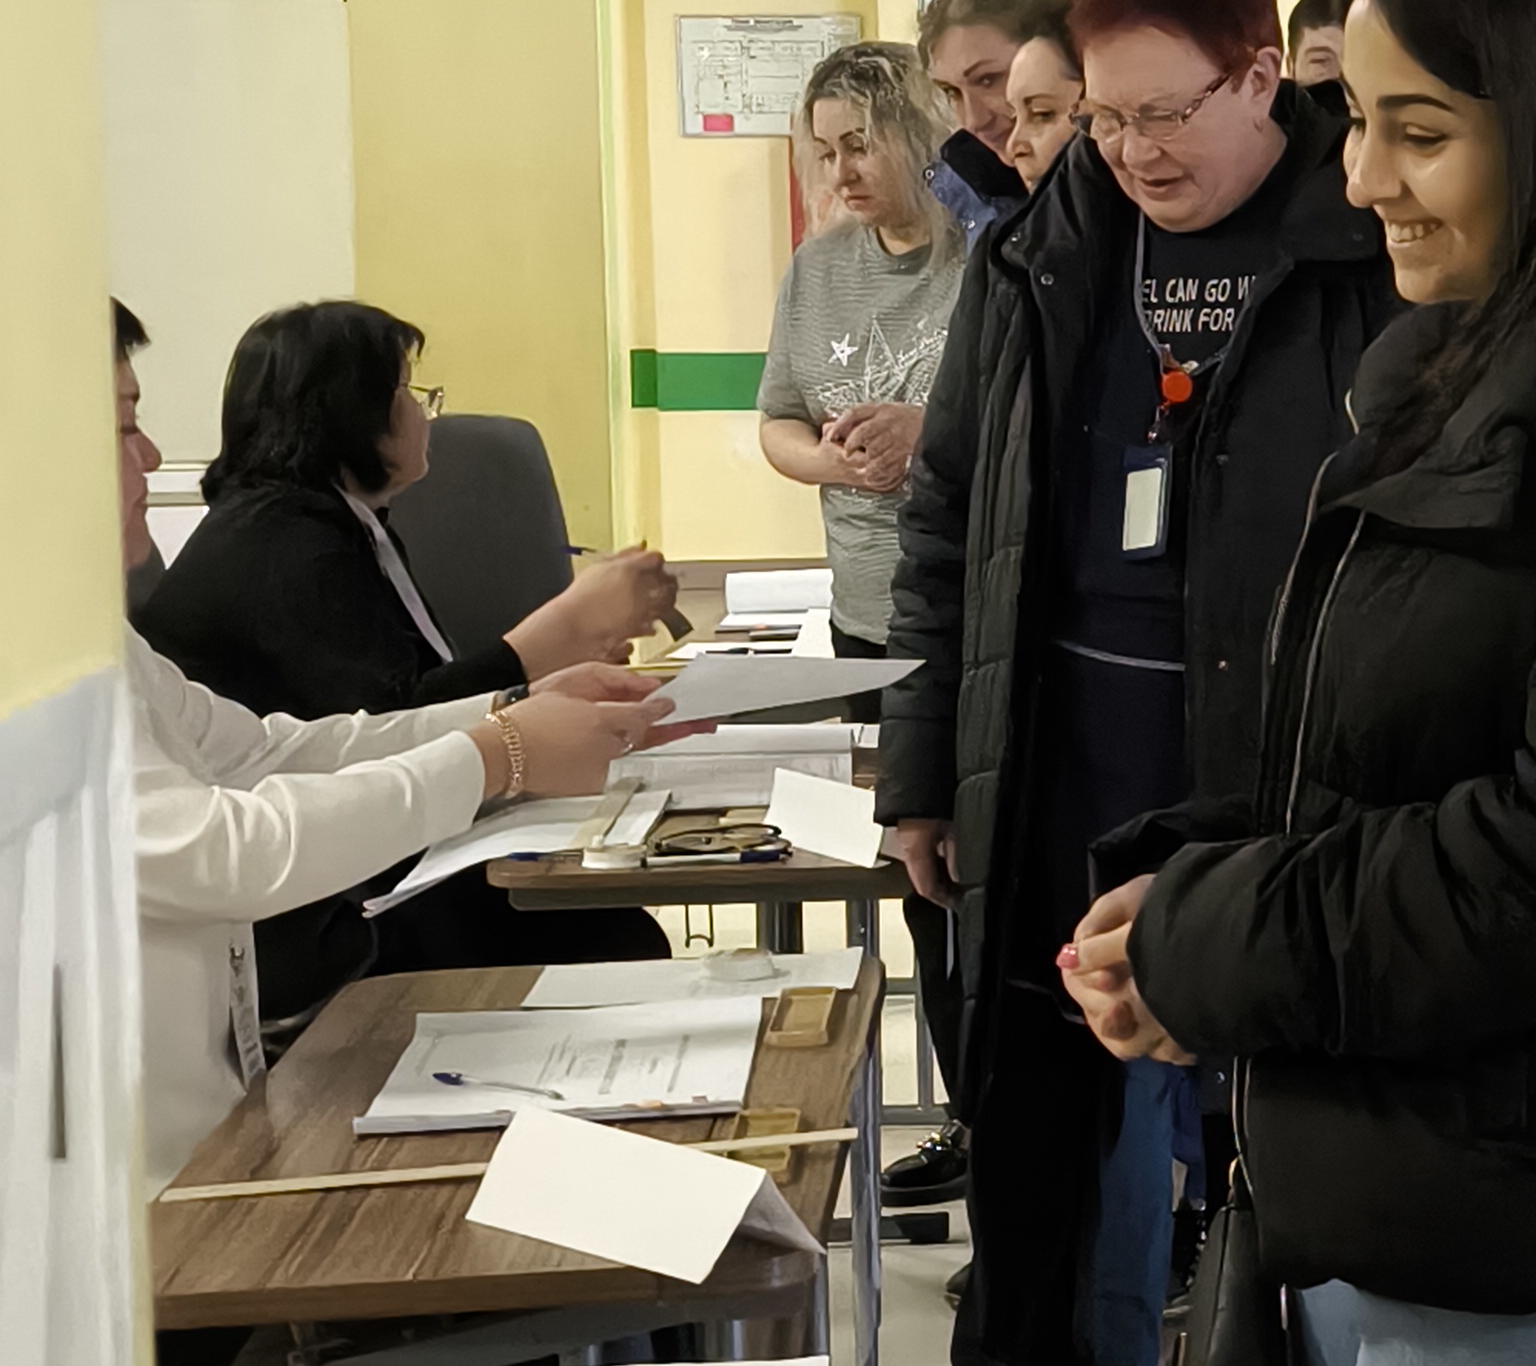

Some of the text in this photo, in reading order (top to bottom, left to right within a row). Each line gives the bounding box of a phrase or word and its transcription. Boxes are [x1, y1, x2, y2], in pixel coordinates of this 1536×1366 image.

[1165, 278, 1199, 303] CAN
[1204, 278, 1231, 302] GO
[1198, 308, 1235, 332] FOR
